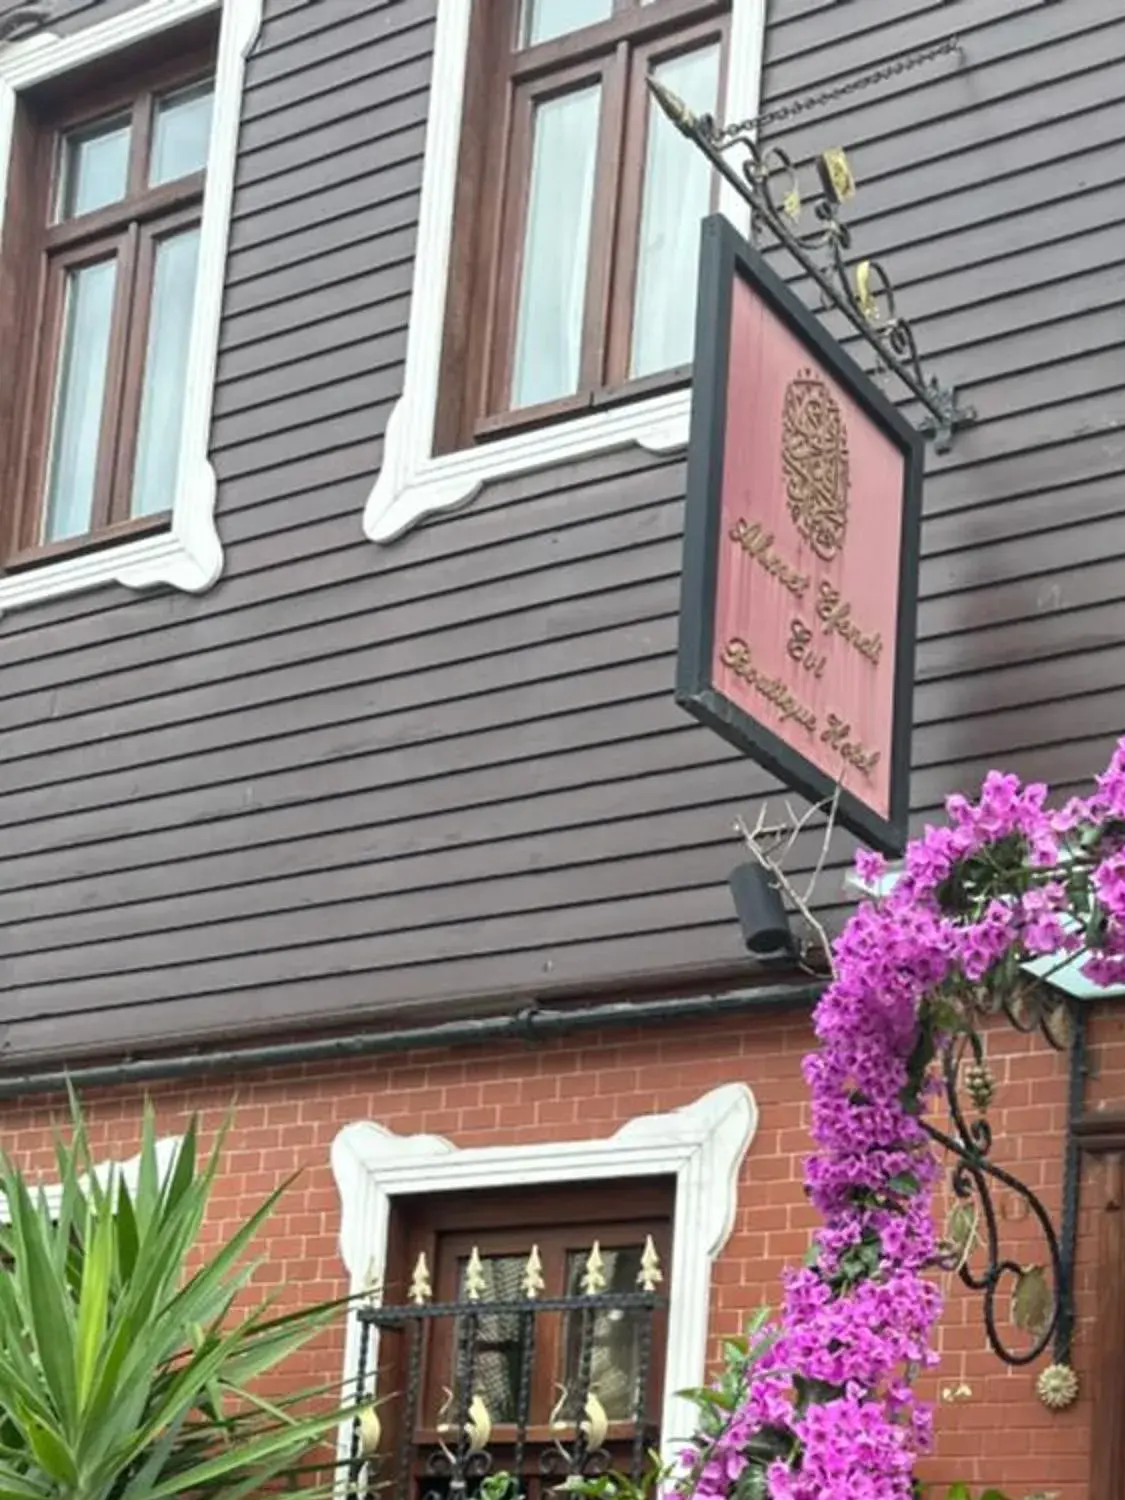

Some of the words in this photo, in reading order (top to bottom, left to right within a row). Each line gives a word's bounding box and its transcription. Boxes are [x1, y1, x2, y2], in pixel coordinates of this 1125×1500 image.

[729, 517, 810, 599] Ahmet
[816, 580, 883, 666] Efendi
[788, 619, 827, 679] Evi
[720, 637, 817, 733] Boutique
[820, 713, 881, 777] Hotel
